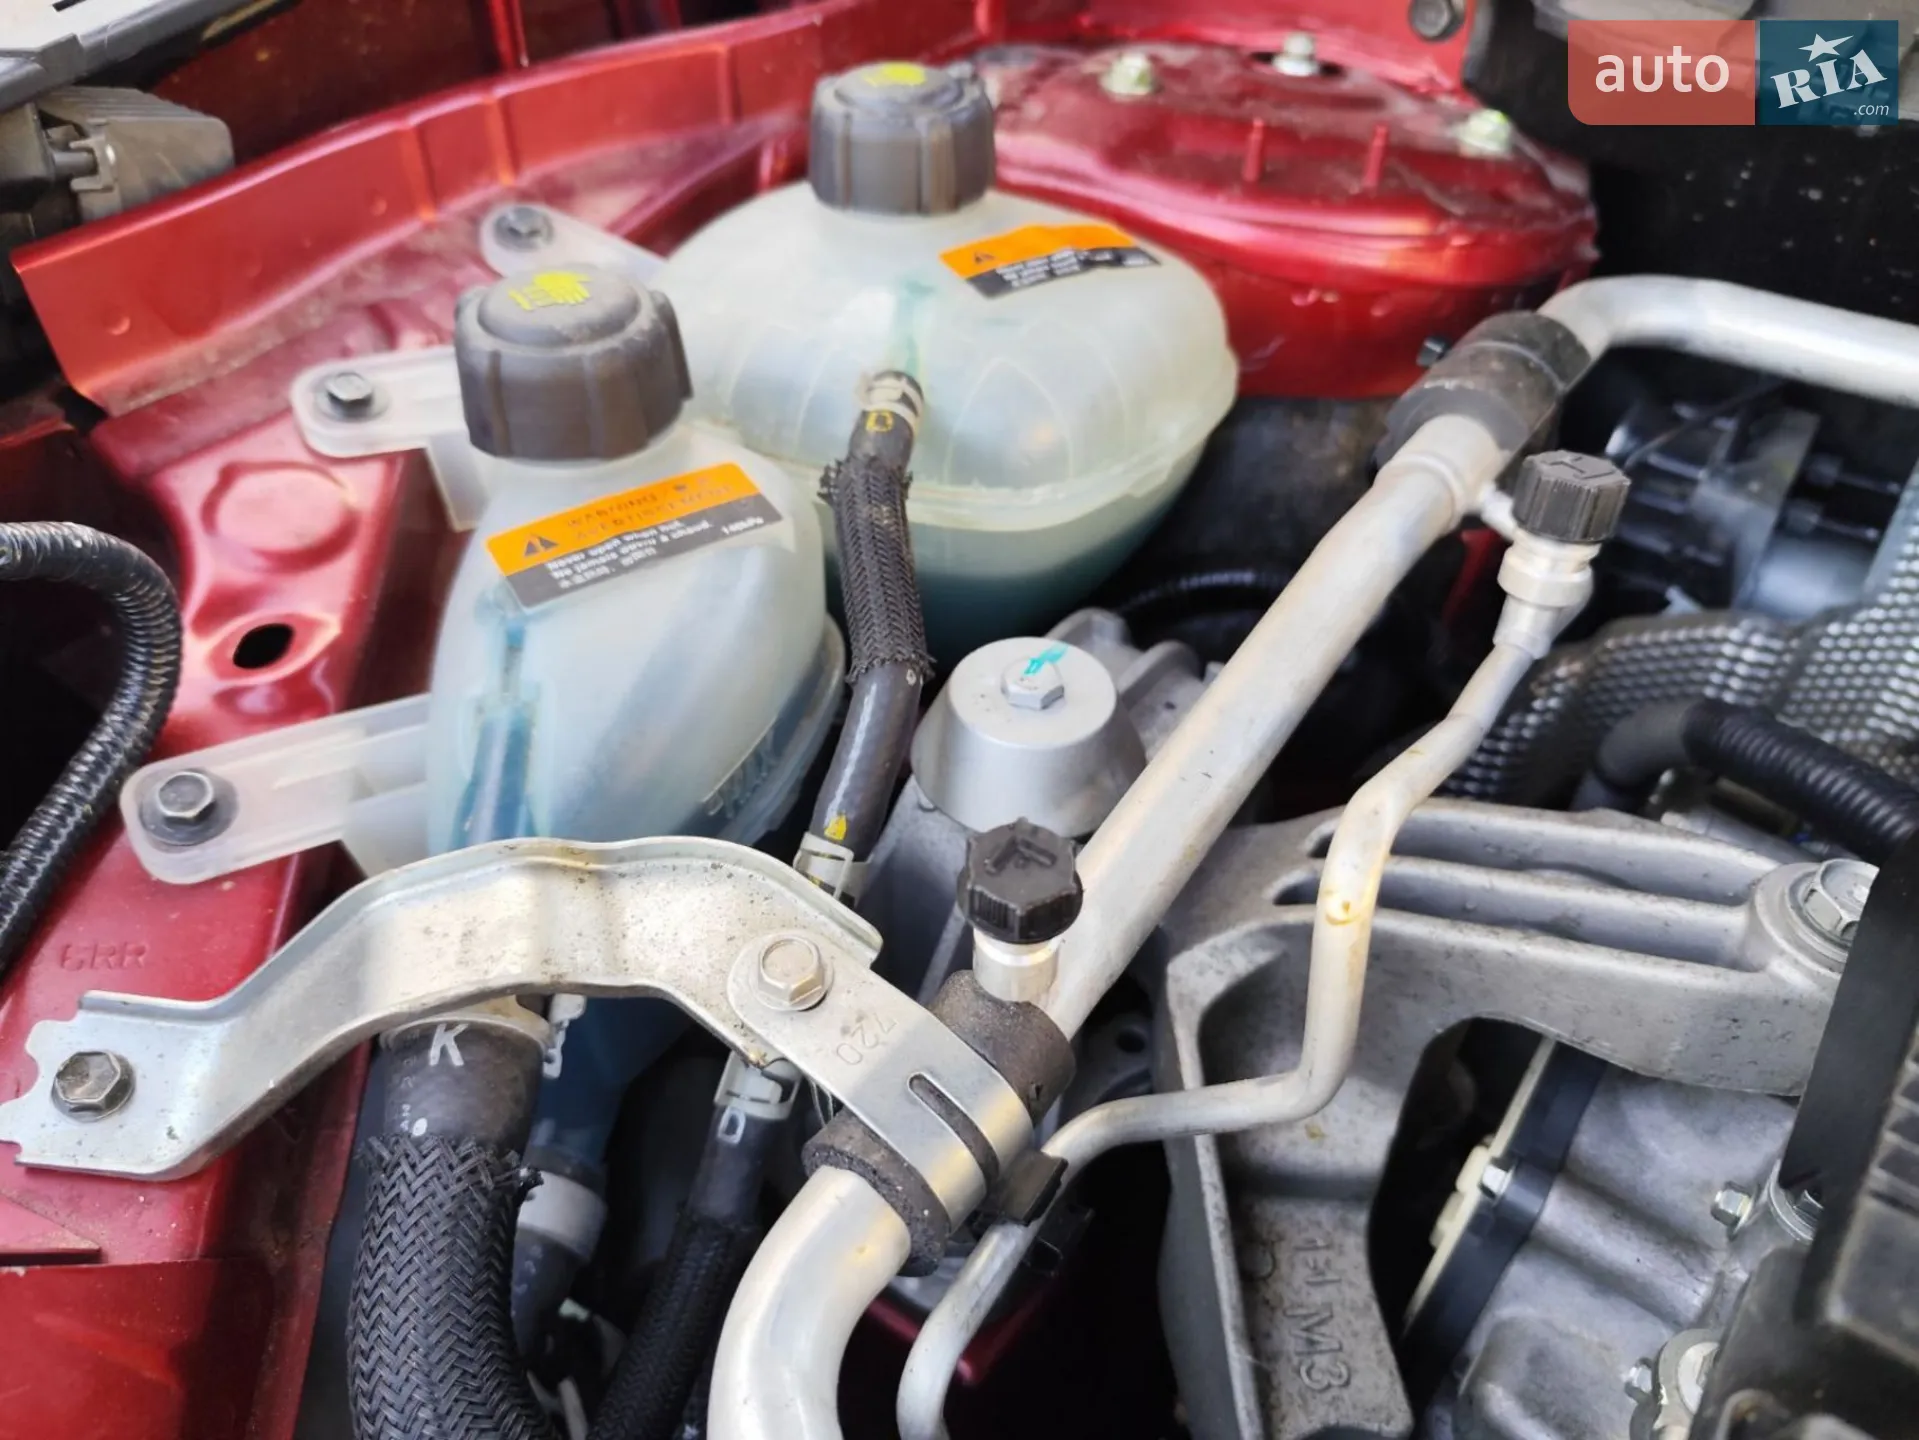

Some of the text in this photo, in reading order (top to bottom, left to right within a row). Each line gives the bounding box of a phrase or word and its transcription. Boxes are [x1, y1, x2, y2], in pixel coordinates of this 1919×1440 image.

[545, 553, 586, 571] Never
[587, 538, 622, 557] open
[428, 1023, 470, 1067] K
